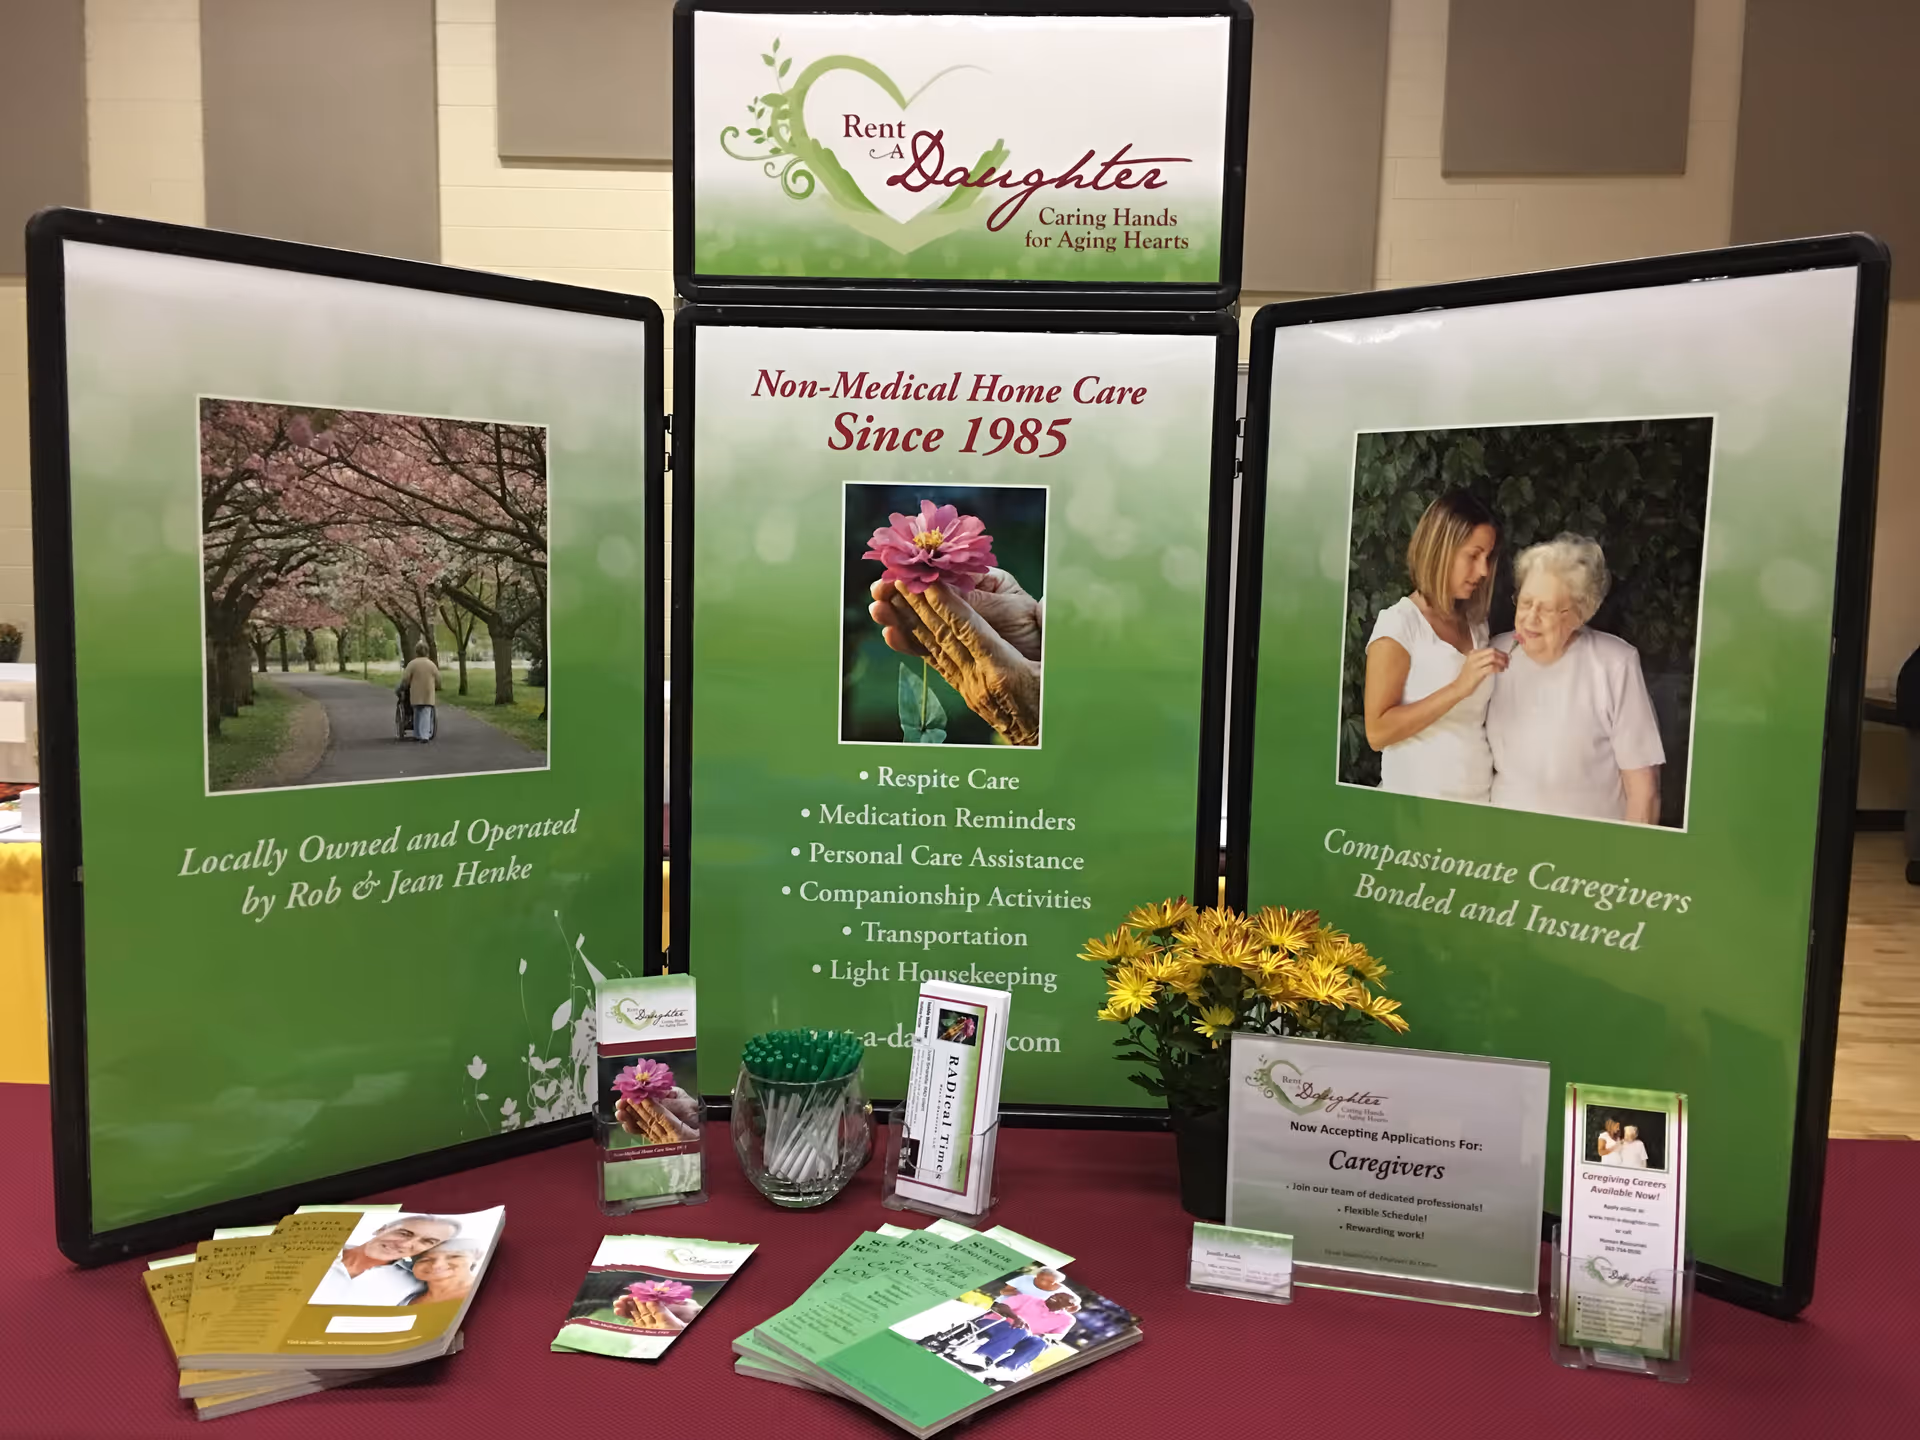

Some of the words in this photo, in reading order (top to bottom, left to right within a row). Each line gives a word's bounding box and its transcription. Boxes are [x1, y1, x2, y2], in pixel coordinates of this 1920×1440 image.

[843, 114, 906, 139] Rent
[886, 129, 1193, 232] Daughter
[1038, 207, 1107, 230] Caring
[1113, 208, 1178, 227] Hands
[1025, 230, 1052, 249] for
[1057, 231, 1117, 252] Aging
[1123, 231, 1190, 250] Hearts
[751, 368, 961, 402] Non-Medical
[966, 373, 1062, 404] Home
[1072, 375, 1148, 406] Care
[828, 411, 945, 453] Since
[958, 416, 1073, 458] 1985
[877, 766, 960, 794] Respite
[967, 768, 1020, 790] Care
[818, 804, 947, 828] Medication
[955, 807, 1076, 831] Reminders
[178, 838, 288, 876] Locally
[299, 825, 402, 863] Owned
[406, 820, 460, 853] and
[466, 808, 581, 852] Operated
[809, 842, 903, 865] Personal
[911, 845, 963, 867] Care
[968, 847, 1085, 871] Assistance
[1323, 828, 1519, 884] Compassionate
[1528, 861, 1692, 914] Caregivers
[241, 886, 276, 923] by
[284, 876, 342, 910] Rob
[351, 870, 381, 901] &
[382, 869, 444, 903] Jean
[452, 855, 534, 888] Henke
[799, 880, 981, 913] Companionship
[986, 886, 1092, 910] Activities
[1354, 873, 1457, 915] Bonded
[1459, 900, 1521, 928] and
[1524, 904, 1646, 952] Insured
[861, 921, 1028, 950] Transportation
[829, 959, 890, 987] Light
[897, 961, 1057, 993] Housekeeping
[942, 1055, 960, 1127] RADical
[1295, 1082, 1389, 1113] Daughter
[1290, 1121, 1317, 1133] Now
[1320, 1124, 1379, 1142] Accepting
[1381, 1131, 1456, 1148] Applications
[1459, 1139, 1483, 1151] For:
[936, 1134, 950, 1180] Times
[1329, 1150, 1446, 1181] Caregivers
[1582, 1172, 1631, 1186] Caregiving
[1632, 1178, 1667, 1189] Careers
[1590, 1185, 1633, 1198] Available
[1635, 1191, 1661, 1201] Now!
[1293, 1182, 1311, 1192] Join
[1313, 1186, 1328, 1194] our
[1330, 1187, 1355, 1197] team
[1357, 1189, 1367, 1198] of
[1369, 1191, 1415, 1204] dedicated
[1416, 1198, 1484, 1213] professionals!
[1344, 1205, 1380, 1218] Flexible
[1381, 1210, 1427, 1223] Schedule!
[1346, 1223, 1395, 1238] Rewarding
[1397, 1230, 1425, 1240] work!
